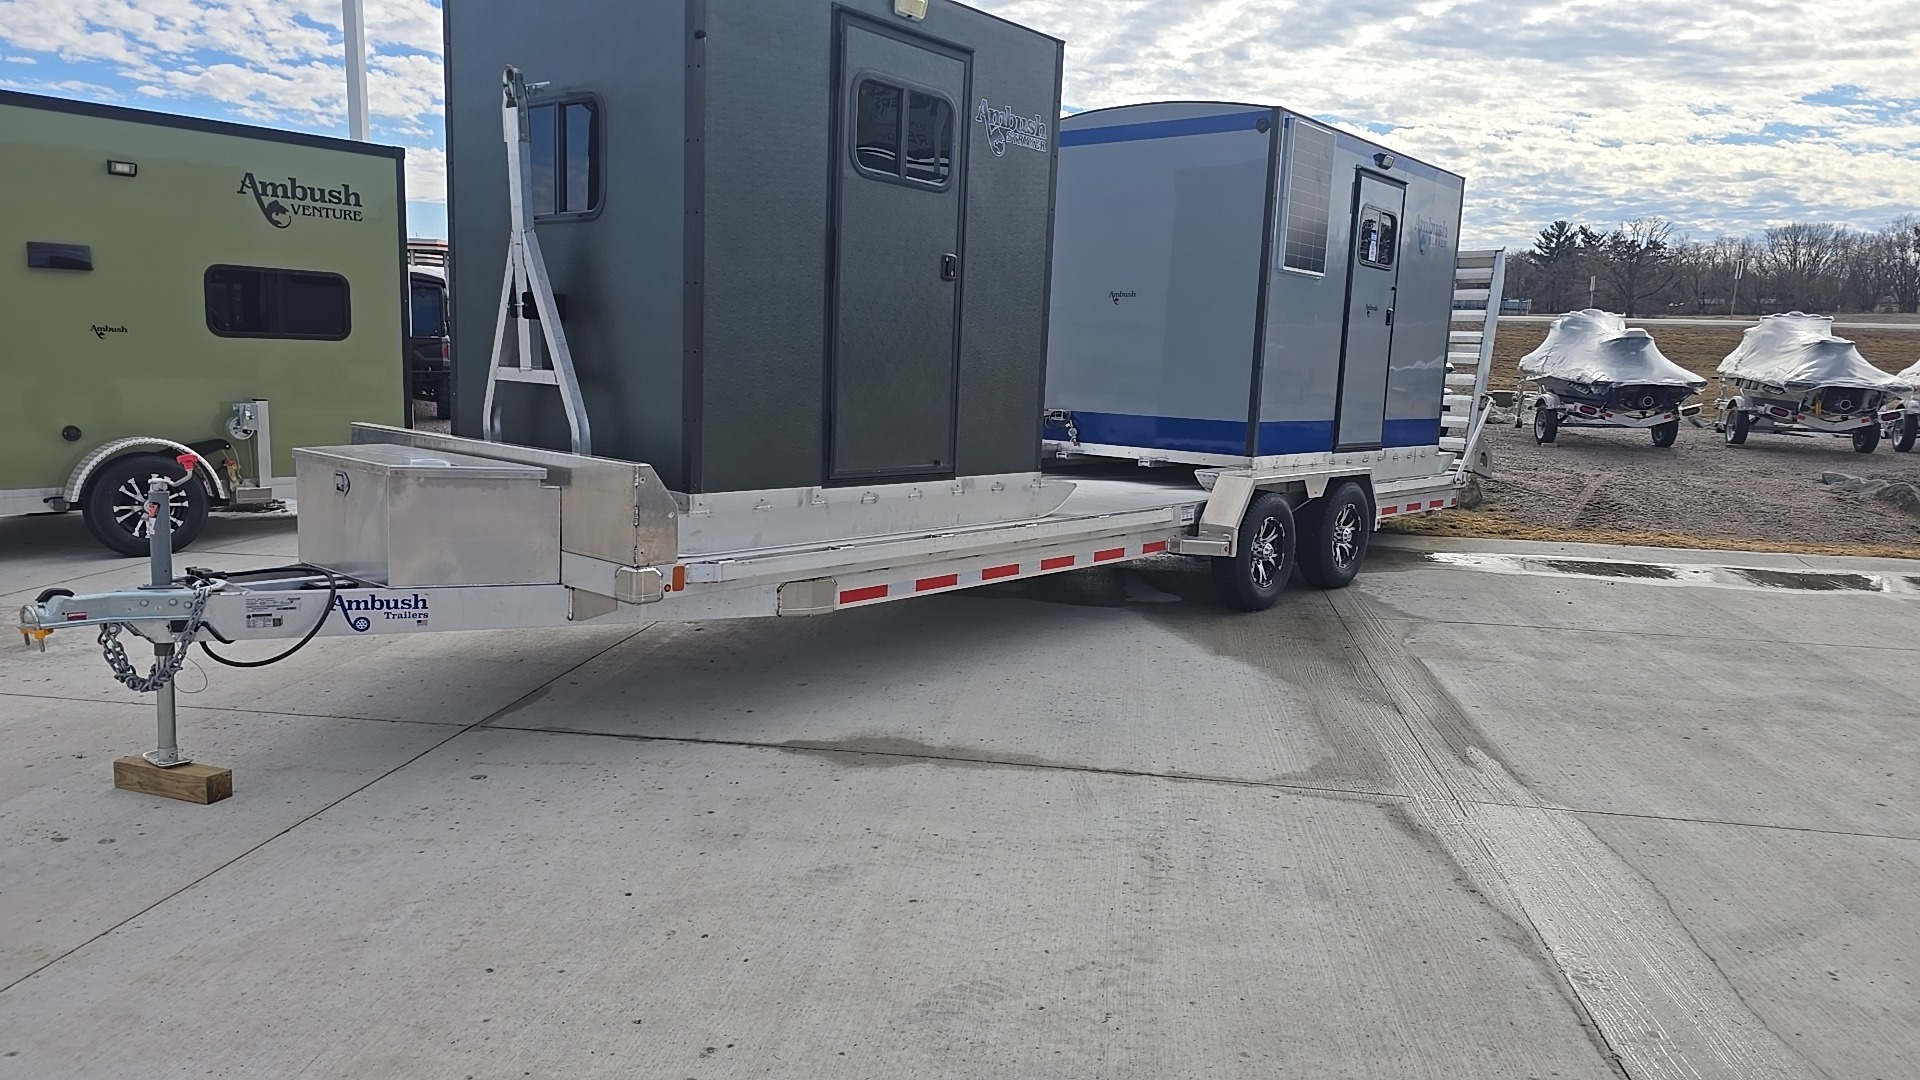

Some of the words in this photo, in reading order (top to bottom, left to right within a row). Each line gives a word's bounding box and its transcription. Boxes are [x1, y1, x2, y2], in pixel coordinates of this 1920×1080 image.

[975, 99, 1047, 140] Ambush
[1005, 131, 1047, 152] STRYKER
[237, 172, 363, 210] Ambush
[290, 203, 363, 221] VENTURE
[1414, 214, 1448, 239] Ambush
[1109, 290, 1137, 299] Ambush
[90, 324, 128, 334] Ambush
[330, 593, 429, 617] Ambush
[384, 611, 429, 620] Trailers
